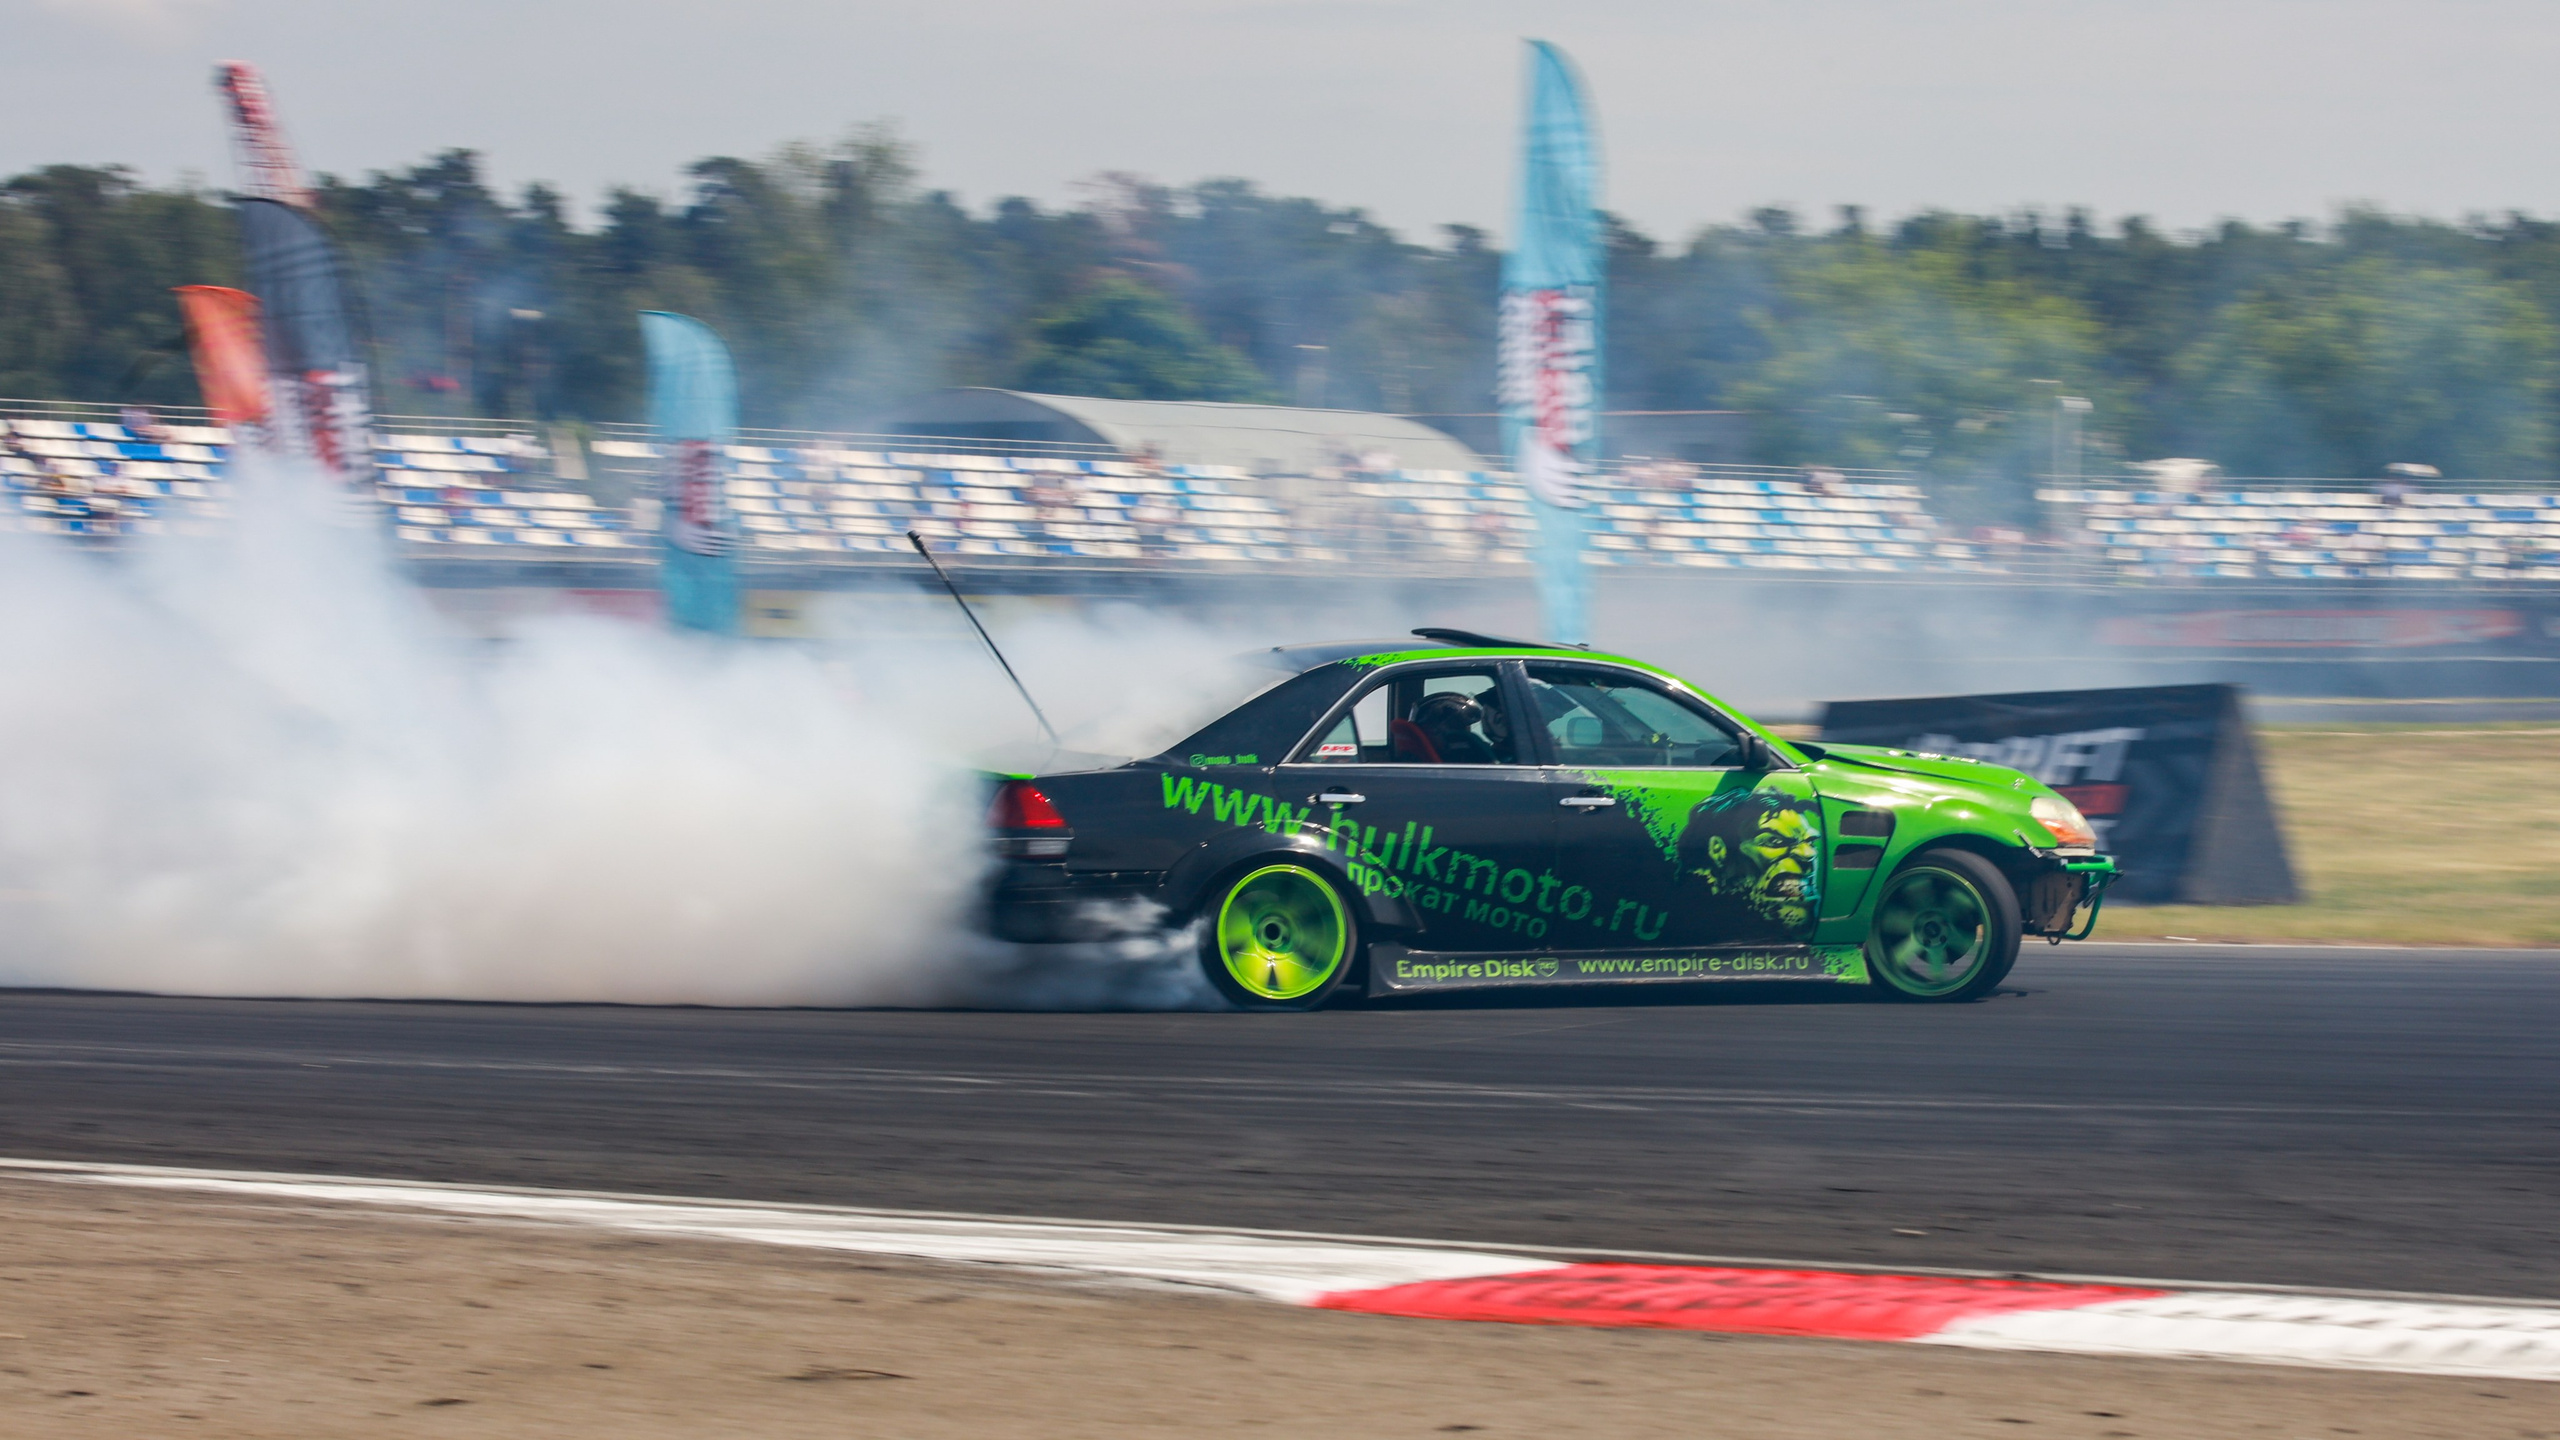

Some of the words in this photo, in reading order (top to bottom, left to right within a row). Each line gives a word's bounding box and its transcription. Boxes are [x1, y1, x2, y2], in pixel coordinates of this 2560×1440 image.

[1161, 772, 1668, 941] www.hulkmoto.ru
[1347, 861, 1460, 914] прокат
[1396, 959, 1482, 982] Empire
[1484, 959, 1537, 978] Disk
[1577, 953, 1809, 976] www.empire-disk.ru
